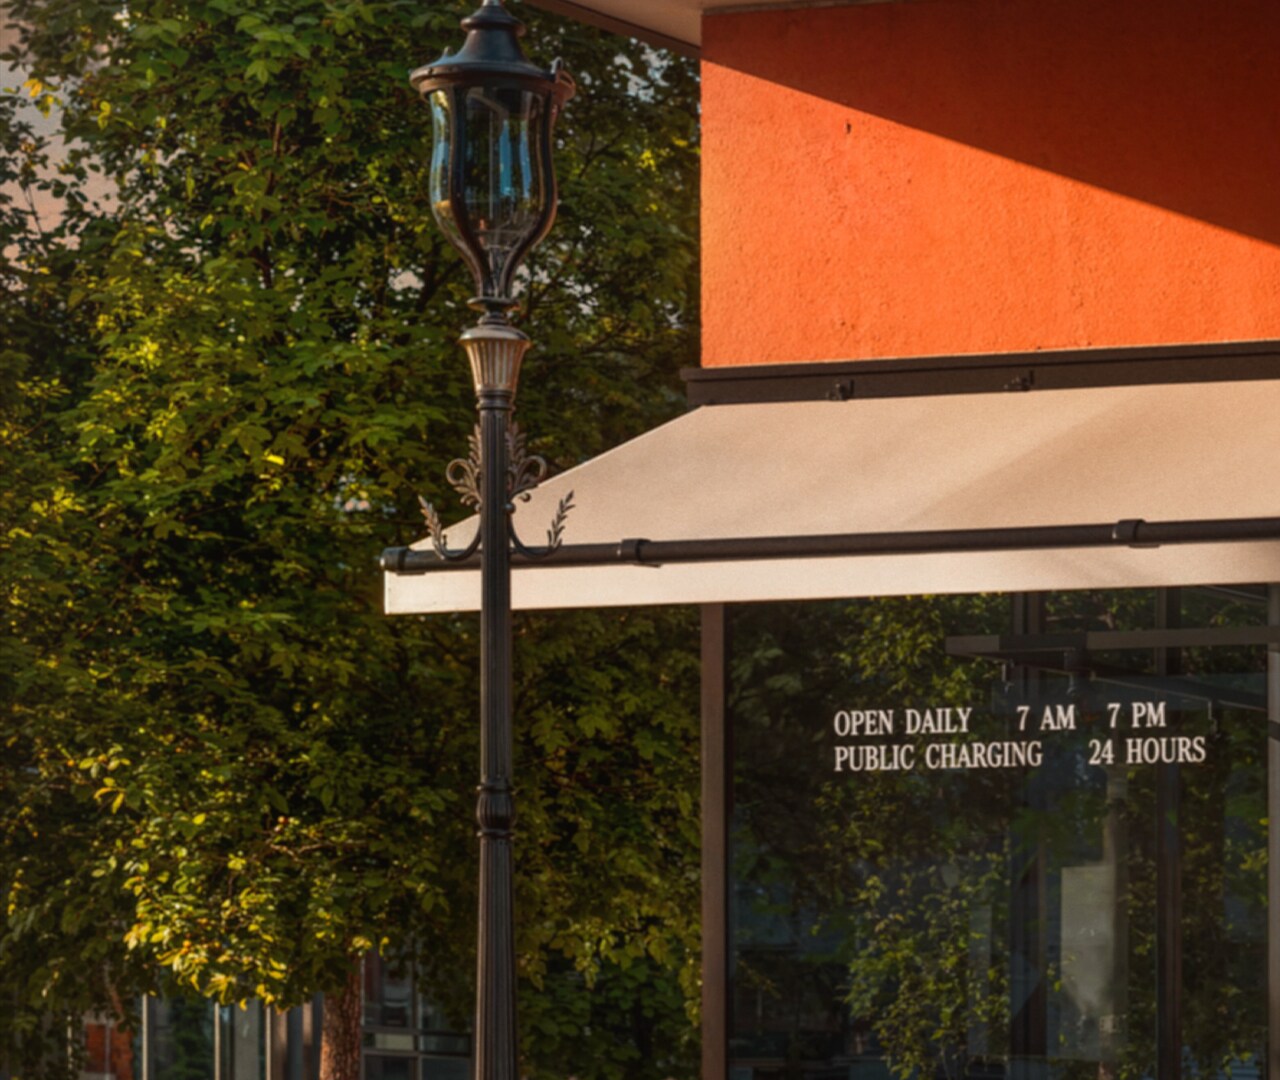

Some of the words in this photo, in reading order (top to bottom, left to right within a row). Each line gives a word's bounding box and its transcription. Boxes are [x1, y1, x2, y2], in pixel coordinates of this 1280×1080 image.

[834, 709, 893, 736] OPEN
[905, 707, 972, 734] DAILY
[1016, 705, 1030, 731] 7
[1039, 703, 1076, 731] AM
[1107, 702, 1121, 729] 7
[1132, 701, 1166, 729] PM
[834, 743, 914, 772] PUBLIC
[925, 741, 1042, 770] CHARGING
[1088, 738, 1114, 766] 24
[1126, 736, 1206, 764] HOURS
